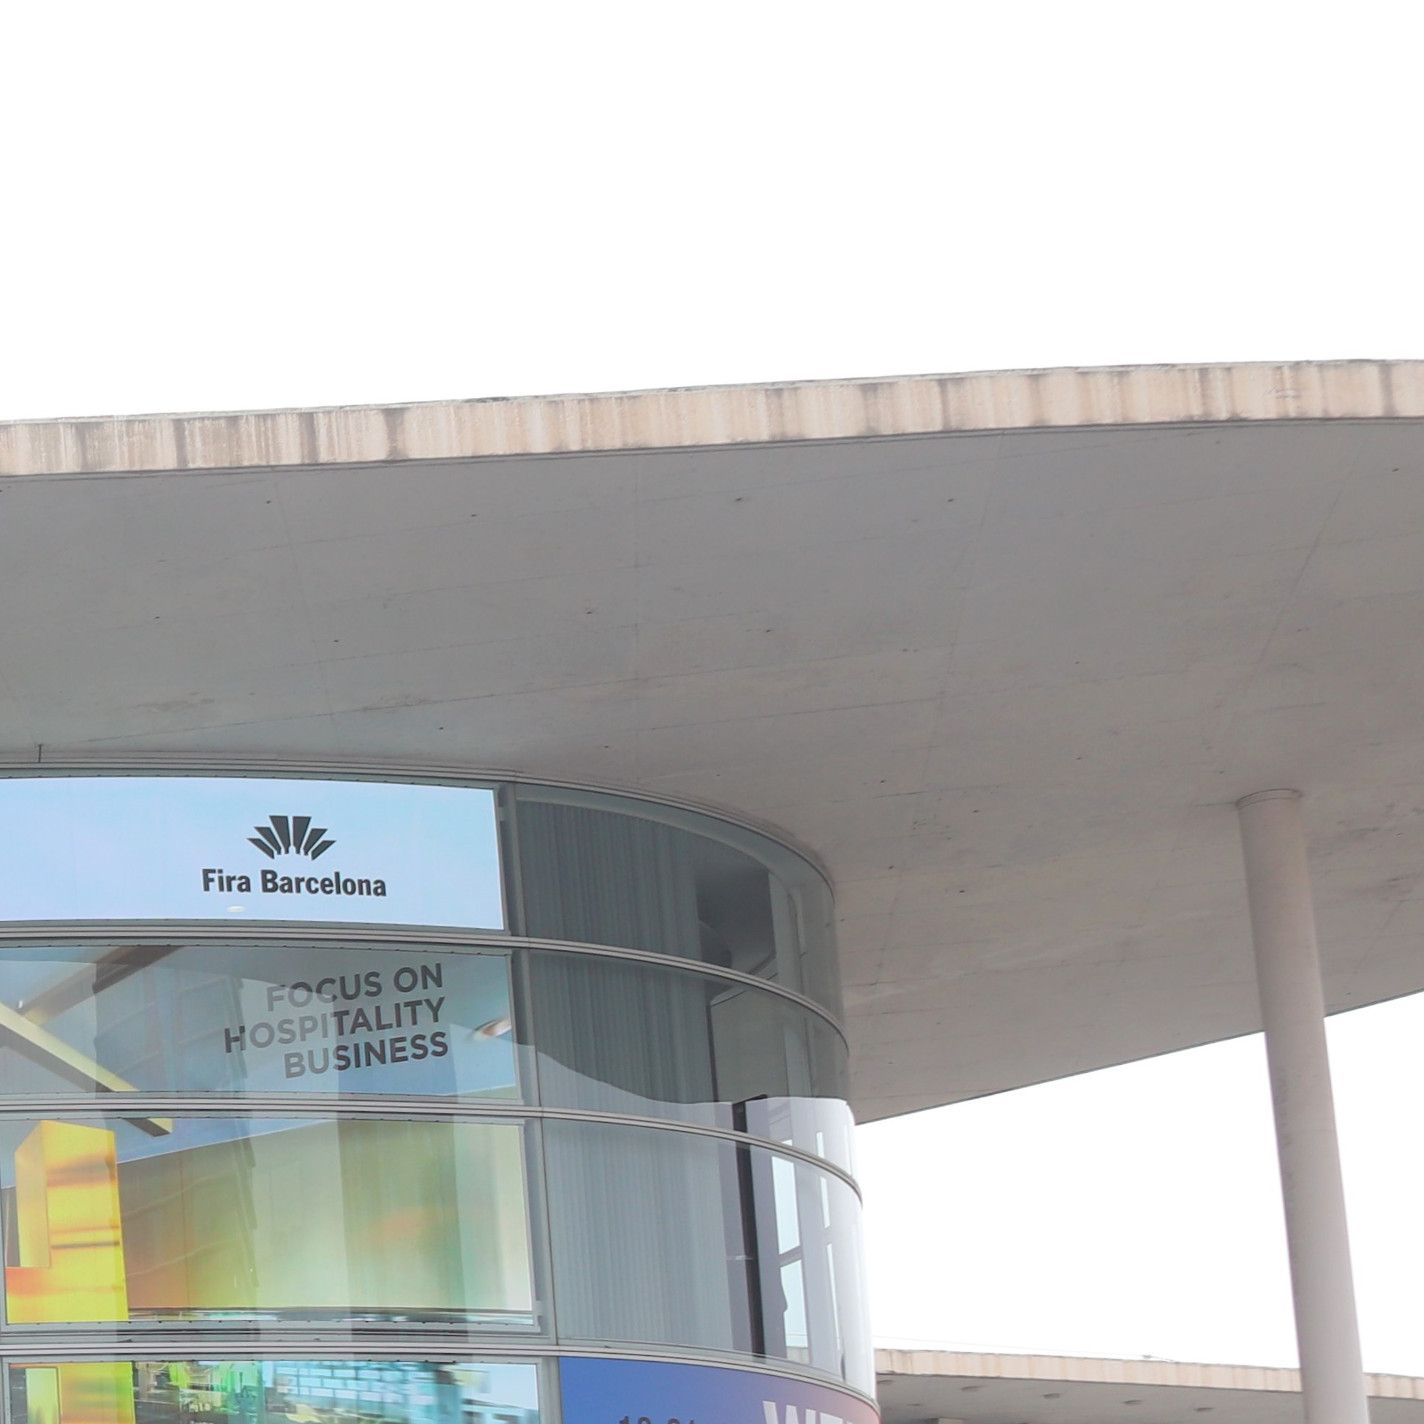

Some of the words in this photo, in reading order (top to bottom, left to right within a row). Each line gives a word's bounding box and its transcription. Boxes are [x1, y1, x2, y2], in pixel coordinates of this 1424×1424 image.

[202, 868, 251, 893] Fira
[261, 869, 386, 897] Barcelona
[266, 971, 382, 1012] FOCUS
[394, 963, 443, 993] ON
[224, 997, 445, 1053] HOSPITALITY
[284, 1032, 449, 1079] BUSINESS
